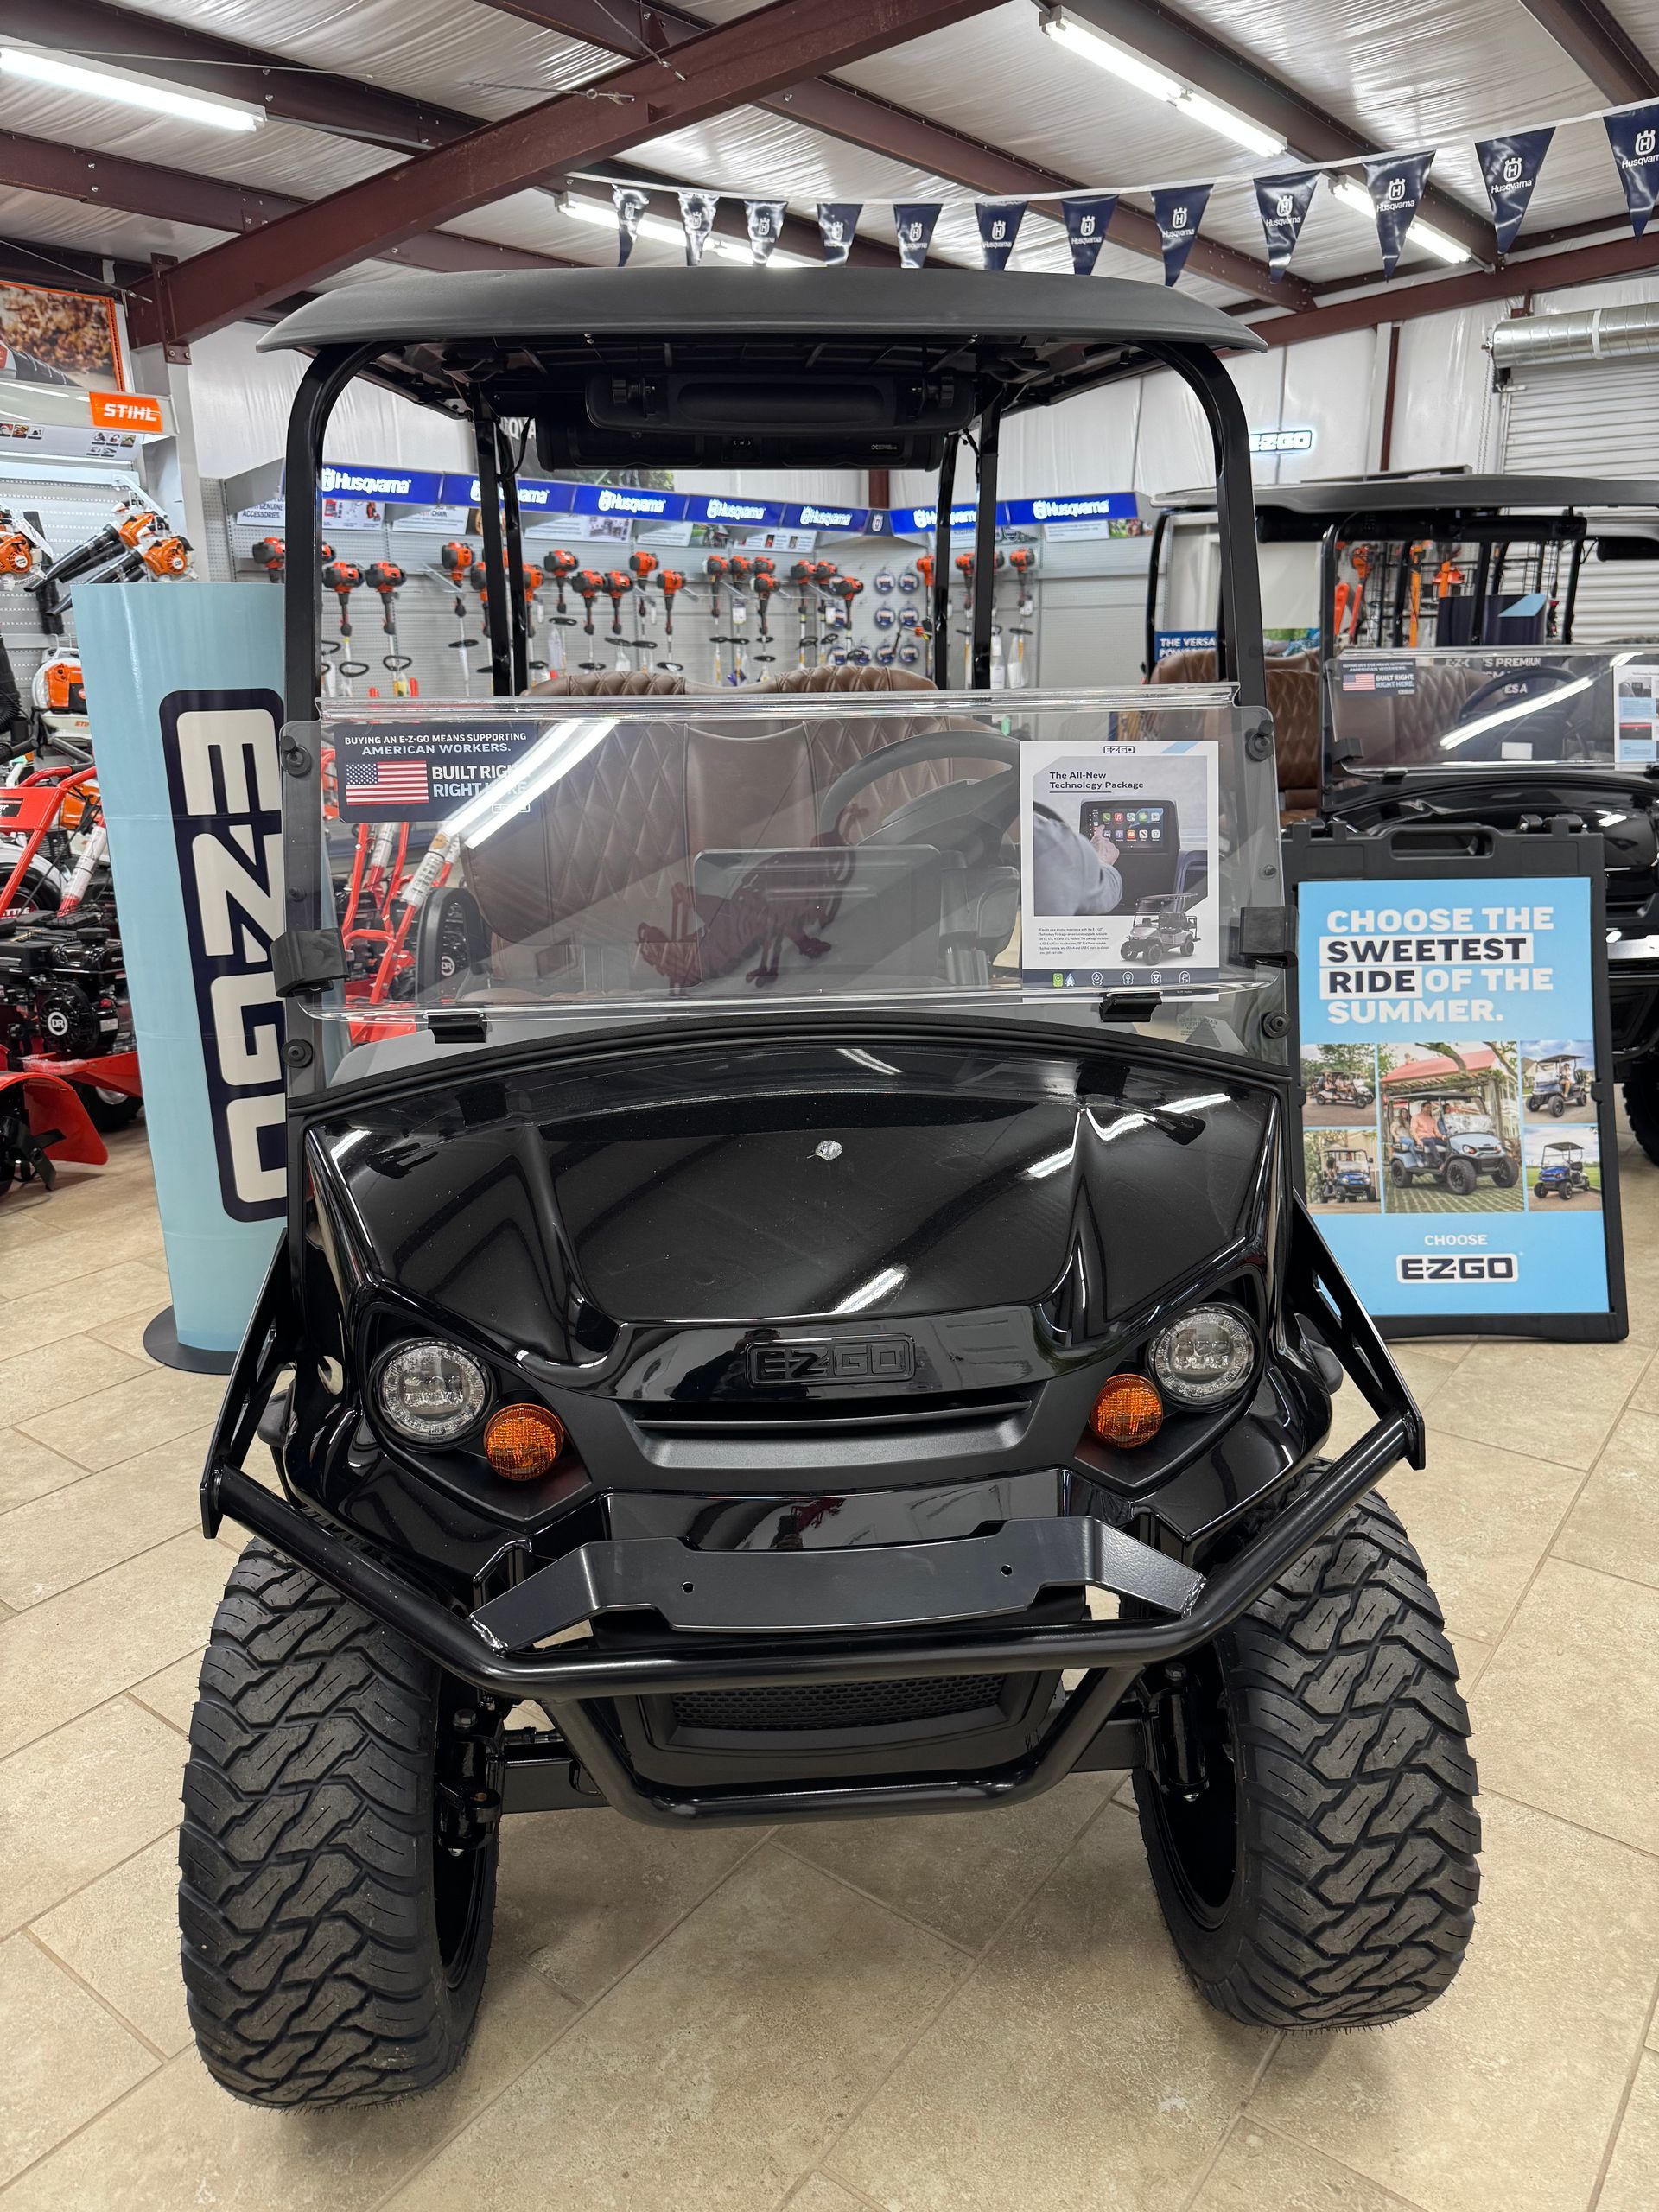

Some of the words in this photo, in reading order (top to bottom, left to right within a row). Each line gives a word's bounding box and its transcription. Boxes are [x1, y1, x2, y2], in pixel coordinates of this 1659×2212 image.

[1491, 178, 1532, 194] Husqvarna
[1376, 200, 1415, 213] Husqvarna
[1266, 214, 1301, 228] Husqvarna
[1162, 228, 1195, 238] Husqvarna
[1071, 236, 1103, 245] Husqvarna
[104, 403, 157, 422] STIHL
[335, 472, 410, 494] Husqvarna
[611, 493, 665, 513] Husqvarna
[1046, 499, 1109, 518] Husqvarna
[721, 503, 766, 519] Husqvarna
[1158, 638, 1181, 647] THE
[345, 736, 381, 745] BUYING
[384, 735, 397, 744] AN
[399, 734, 430, 743] E-Z-GO
[432, 734, 466, 742] MEANS
[467, 733, 527, 741] SUPPORTING
[362, 744, 435, 755] AMERICAN
[440, 743, 512, 753] WORKERS.
[432, 766, 477, 780] BUILT
[434, 783, 481, 798] RIGHT
[1050, 781, 1103, 790] Technology
[1327, 908, 1474, 933] CHOOSE
[1482, 906, 1554, 931] THE
[1327, 938, 1527, 963] SWEETEST
[1328, 969, 1415, 993] RIDE
[1424, 969, 1473, 992] OF
[1480, 968, 1554, 992] THE
[1327, 999, 1503, 1024] SUMMER.
[52, 1019, 64, 1028] DR
[1424, 1234, 1488, 1246] CHOOSE
